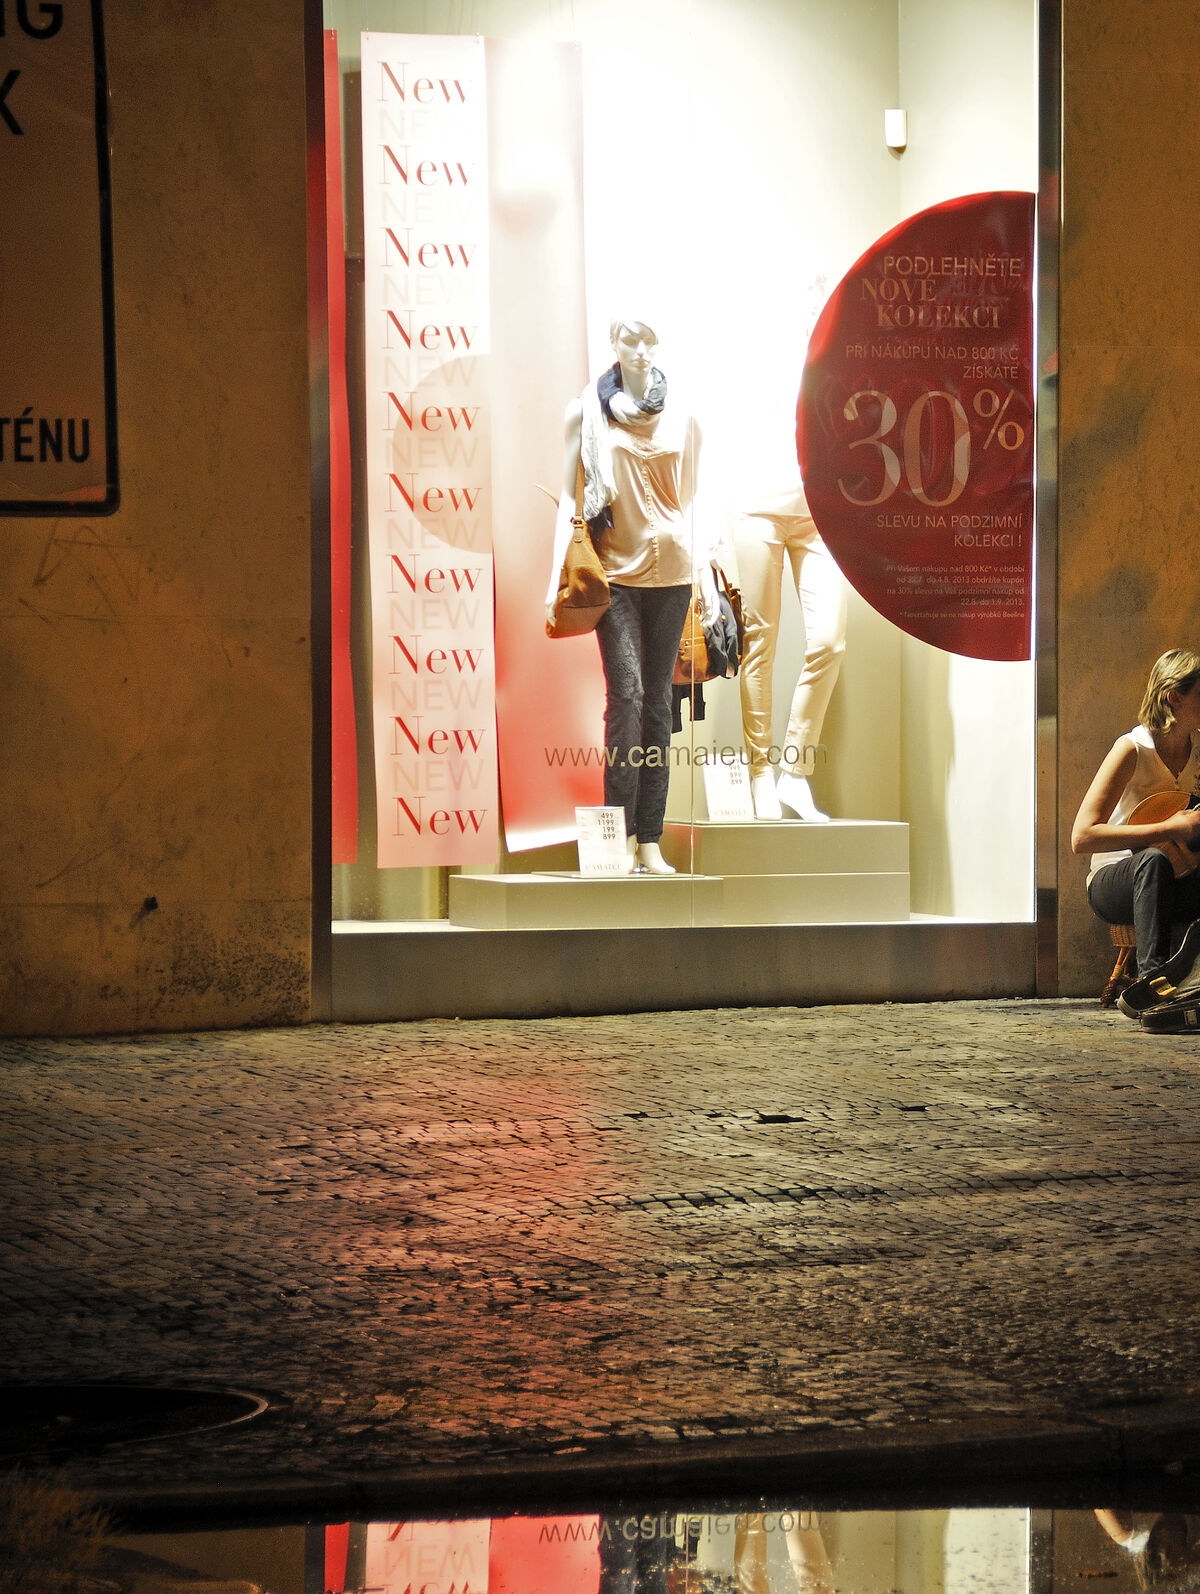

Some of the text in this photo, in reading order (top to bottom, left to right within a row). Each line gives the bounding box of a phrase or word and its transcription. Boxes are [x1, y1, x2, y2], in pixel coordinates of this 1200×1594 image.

[376, 61, 472, 104] New
[378, 144, 475, 187] New
[379, 226, 477, 269] New
[883, 253, 1022, 277] PODLEHNĚTE
[861, 273, 937, 301] NOVÉ
[380, 309, 479, 350] New
[875, 304, 1001, 328] KOLEKCI
[846, 343, 867, 359] PŘI
[872, 343, 930, 359] NÁKUPU
[935, 346, 967, 359] NAD
[972, 347, 995, 360] 800
[384, 356, 477, 387] NEW
[382, 391, 481, 432] New
[385, 437, 479, 469] NEW
[838, 389, 1025, 507] 30%
[383, 472, 483, 513] New
[387, 518, 480, 550] NEW
[876, 512, 1023, 529] SLEVU NA PODZIMNÍ
[954, 534, 1014, 547] KOLEKCI
[386, 553, 483, 594] New
[389, 599, 481, 630] NEW
[388, 634, 485, 675] New
[391, 679, 482, 711] NEW
[389, 715, 487, 756] New
[544, 739, 828, 767] www.camaieu.com
[392, 759, 484, 791] NEW
[392, 796, 488, 836] New
